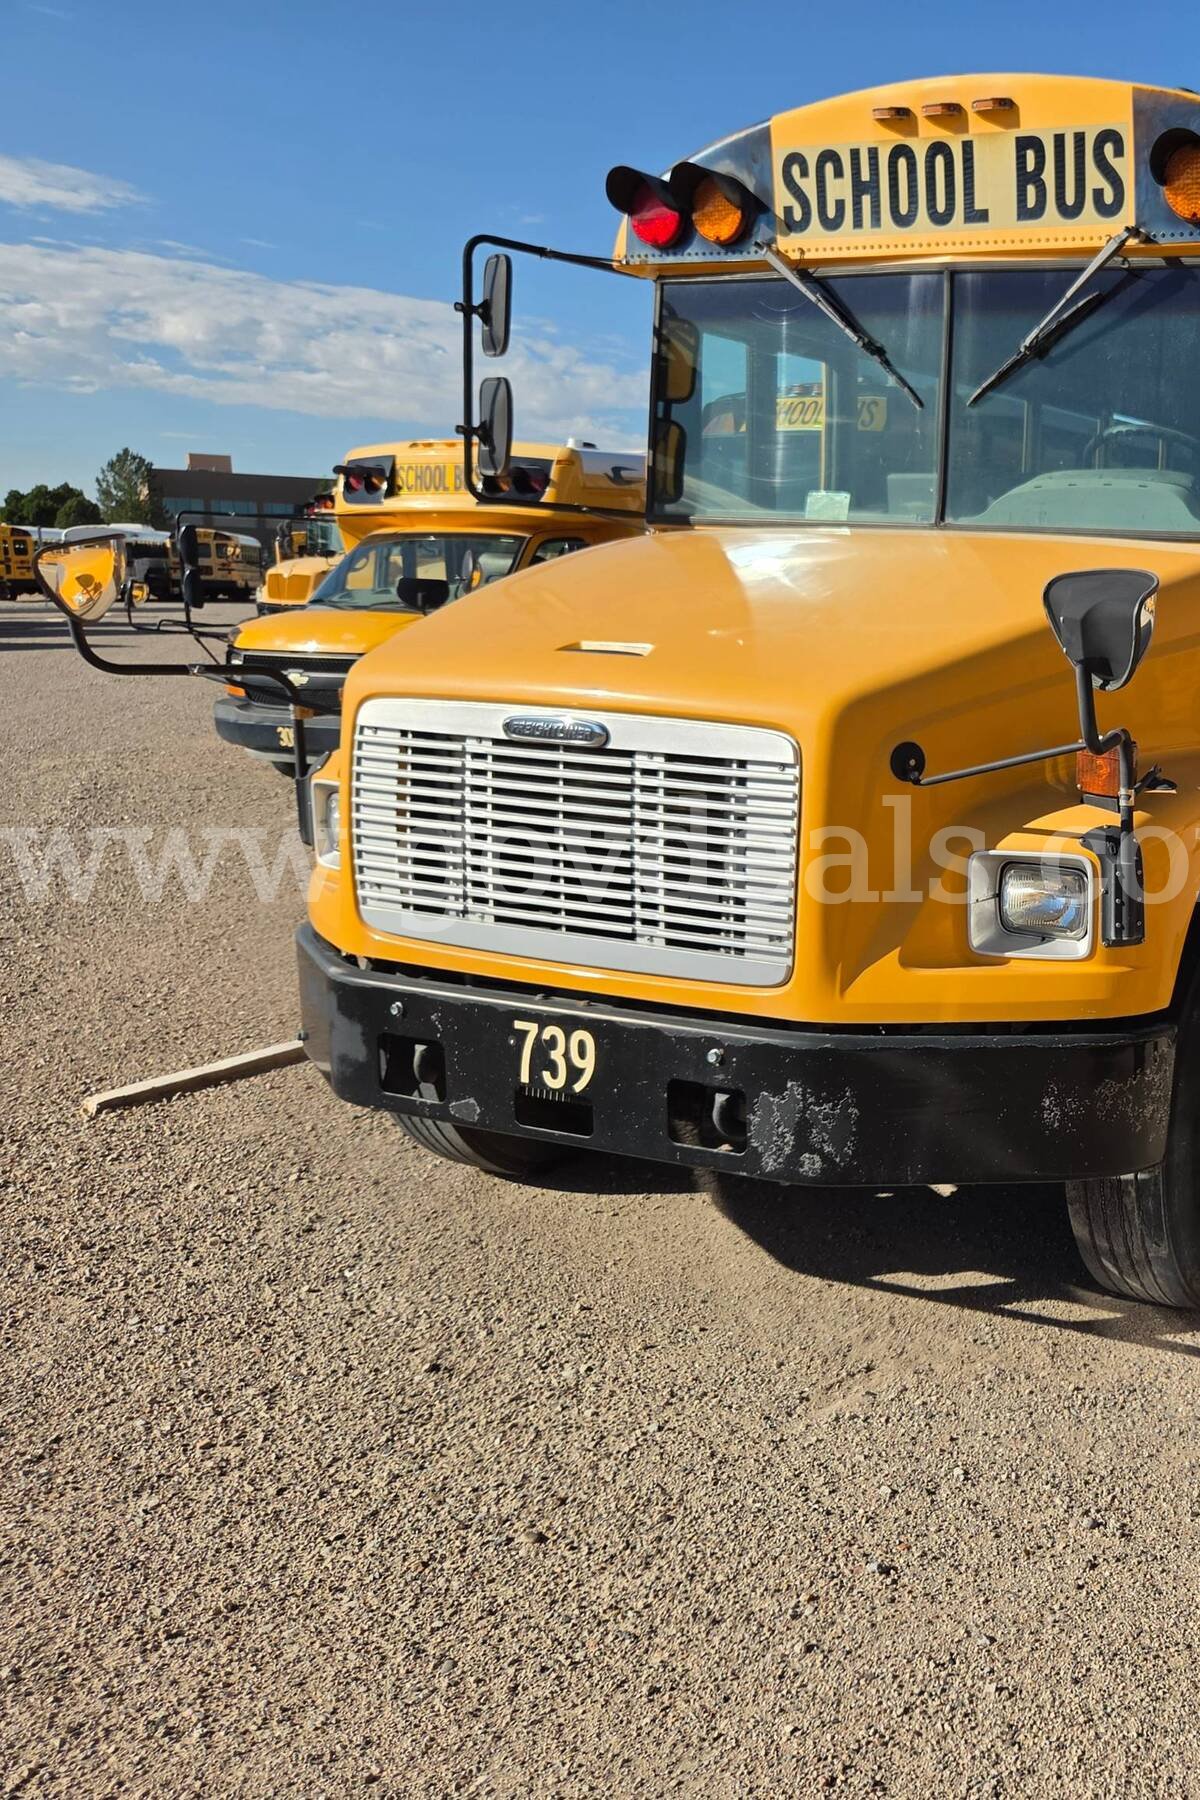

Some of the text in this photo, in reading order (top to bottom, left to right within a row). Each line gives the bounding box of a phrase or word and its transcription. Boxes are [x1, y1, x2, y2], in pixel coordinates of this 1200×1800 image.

[782, 128, 1125, 234] SCHOOL BUS
[398, 465, 449, 492] SCHOOL
[513, 1019, 596, 1094] 739
